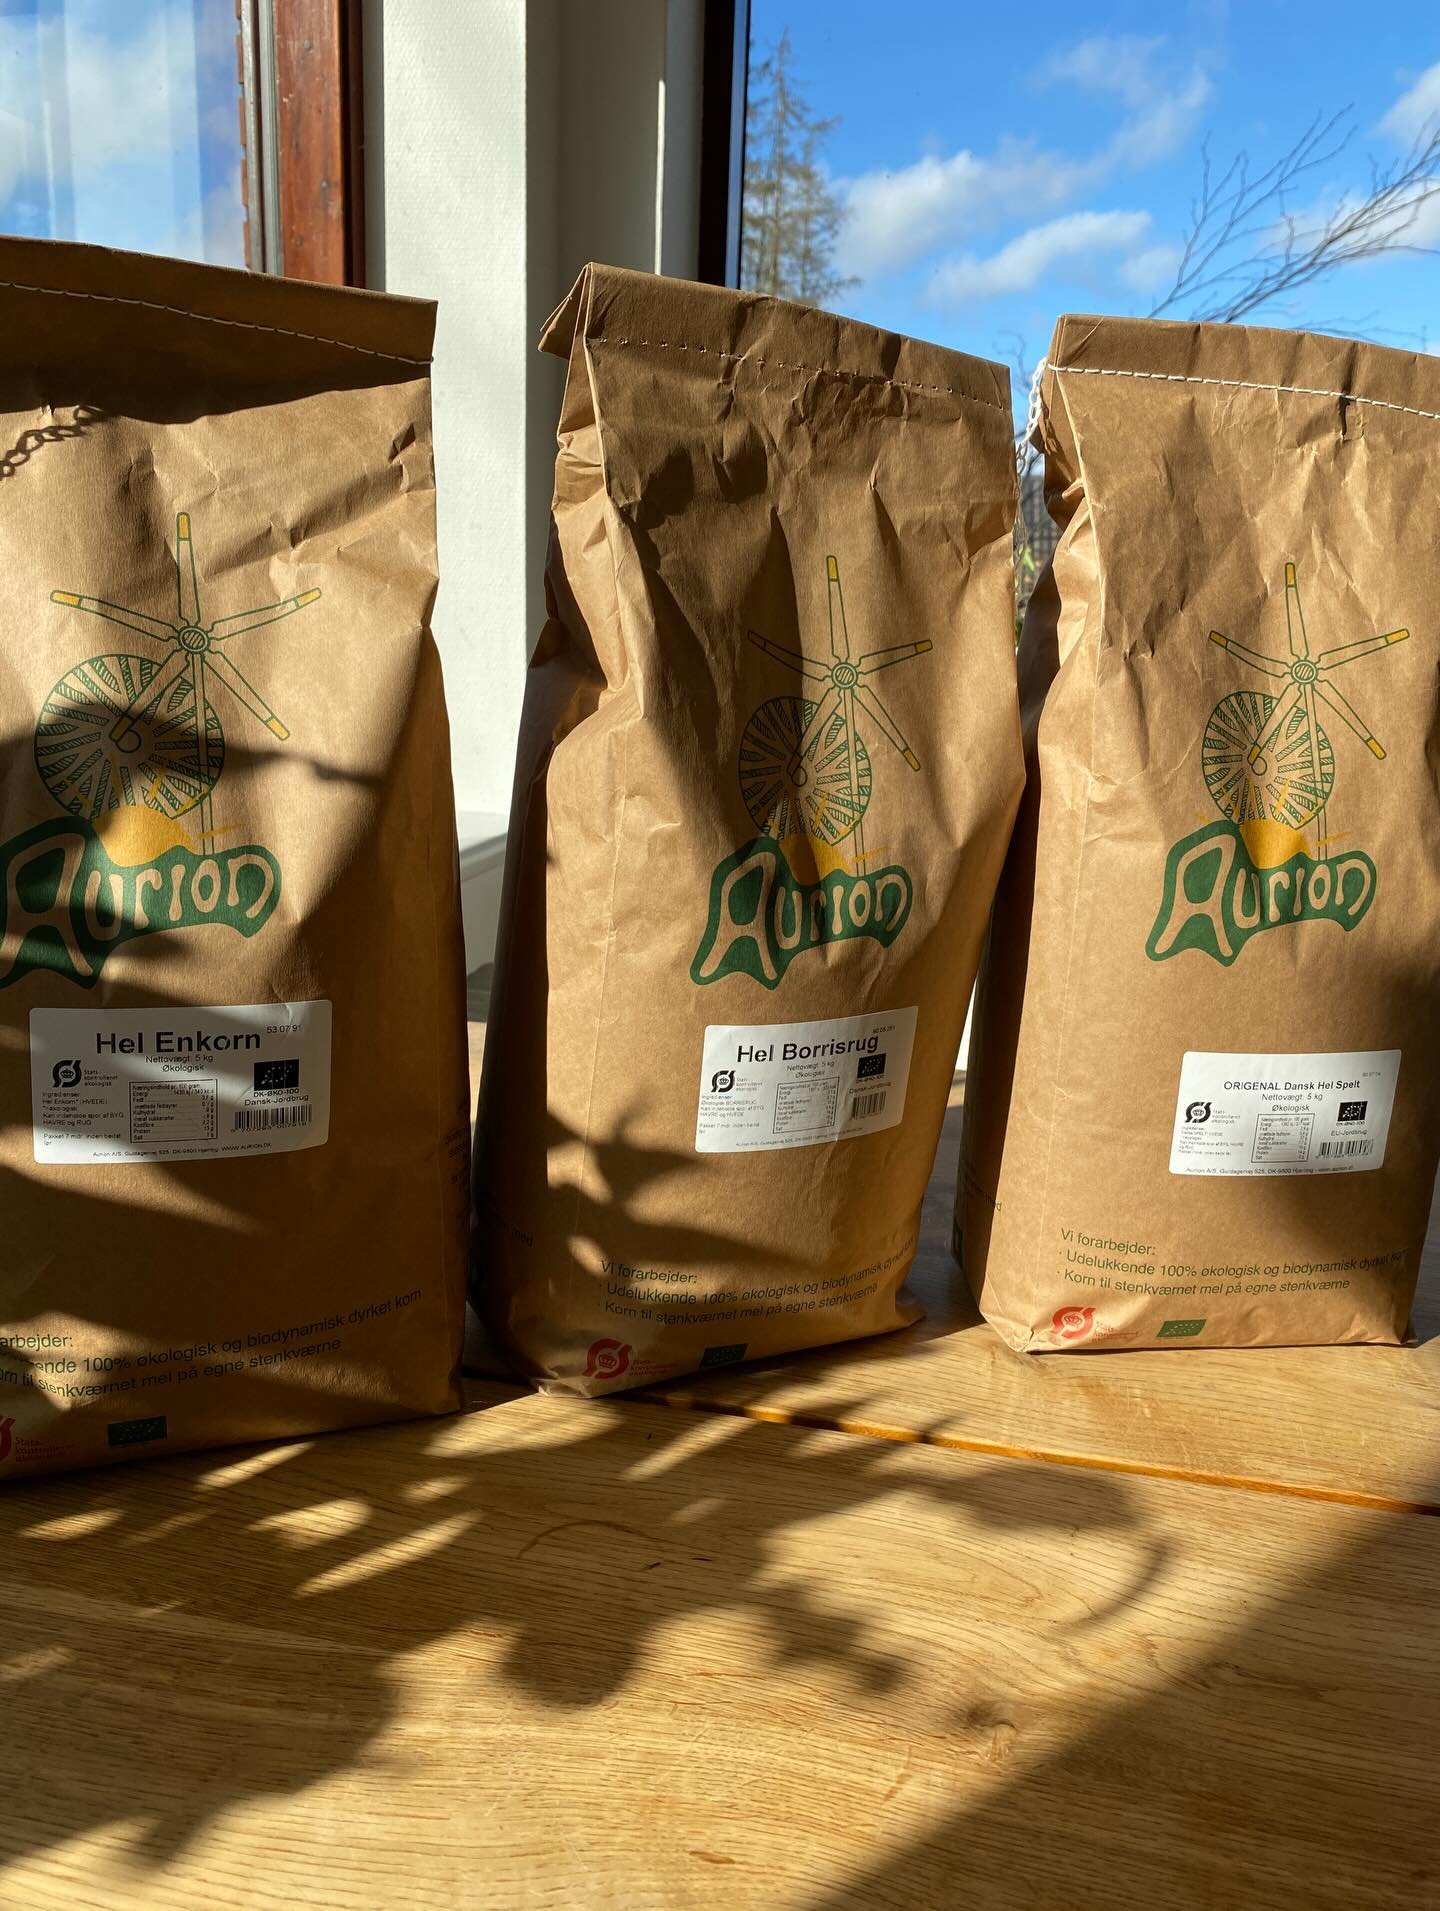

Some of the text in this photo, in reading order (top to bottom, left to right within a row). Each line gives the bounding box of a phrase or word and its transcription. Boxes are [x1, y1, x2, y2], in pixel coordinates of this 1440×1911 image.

[1154, 834, 1371, 957] Aurion
[700, 851, 908, 981] Aurion
[96, 1031, 261, 1054] Hel Enkorn
[737, 1035, 879, 1063] Hel Borrisrug
[162, 1064, 205, 1074] Økologisk
[195, 1054, 201, 1062] 5
[203, 1054, 214, 1063] kg
[1223, 1080, 1361, 1091] ORIGENAL Dansk Hel Spelt
[1307, 1092, 1313, 1101] 5
[1314, 1092, 1324, 1102] kg
[1271, 1103, 1311, 1113] Økologisk
[1061, 1227, 1156, 1256] Vi forarbejder:
[601, 1260, 698, 1284] Vi forarbejder:
[1066, 1250, 1155, 1275] Udelukkende
[1160, 1264, 1197, 1278] 100%
[1201, 1263, 1260, 1279] økologisk
[1263, 1265, 1280, 1278] og
[1282, 1256, 1358, 1276] biodynamisk
[607, 1283, 697, 1305] Udelukkende
[703, 1291, 738, 1305] 100%
[741, 1283, 801, 1300] økologisk
[803, 1283, 819, 1295] og
[821, 1264, 882, 1291] biodynamisk
[1064, 1268, 1350, 1296] Korn til stenkværnet mel på egne stenkværne
[605, 1283, 878, 1326] Korn til stenkværnet mel på egne stenkværne
[83, 1356, 131, 1374] 100%
[137, 1342, 217, 1367] økologisk
[222, 1338, 242, 1353] og
[246, 1314, 346, 1347] biodynamisk
[348, 1299, 392, 1325] dyrket
[22, 1372, 35, 1387] til
[38, 1377, 137, 1398] stenkværnet
[142, 1373, 173, 1387] mel
[177, 1368, 199, 1385] på
[203, 1361, 245, 1378] egne
[249, 1338, 342, 1367] stenkværne
